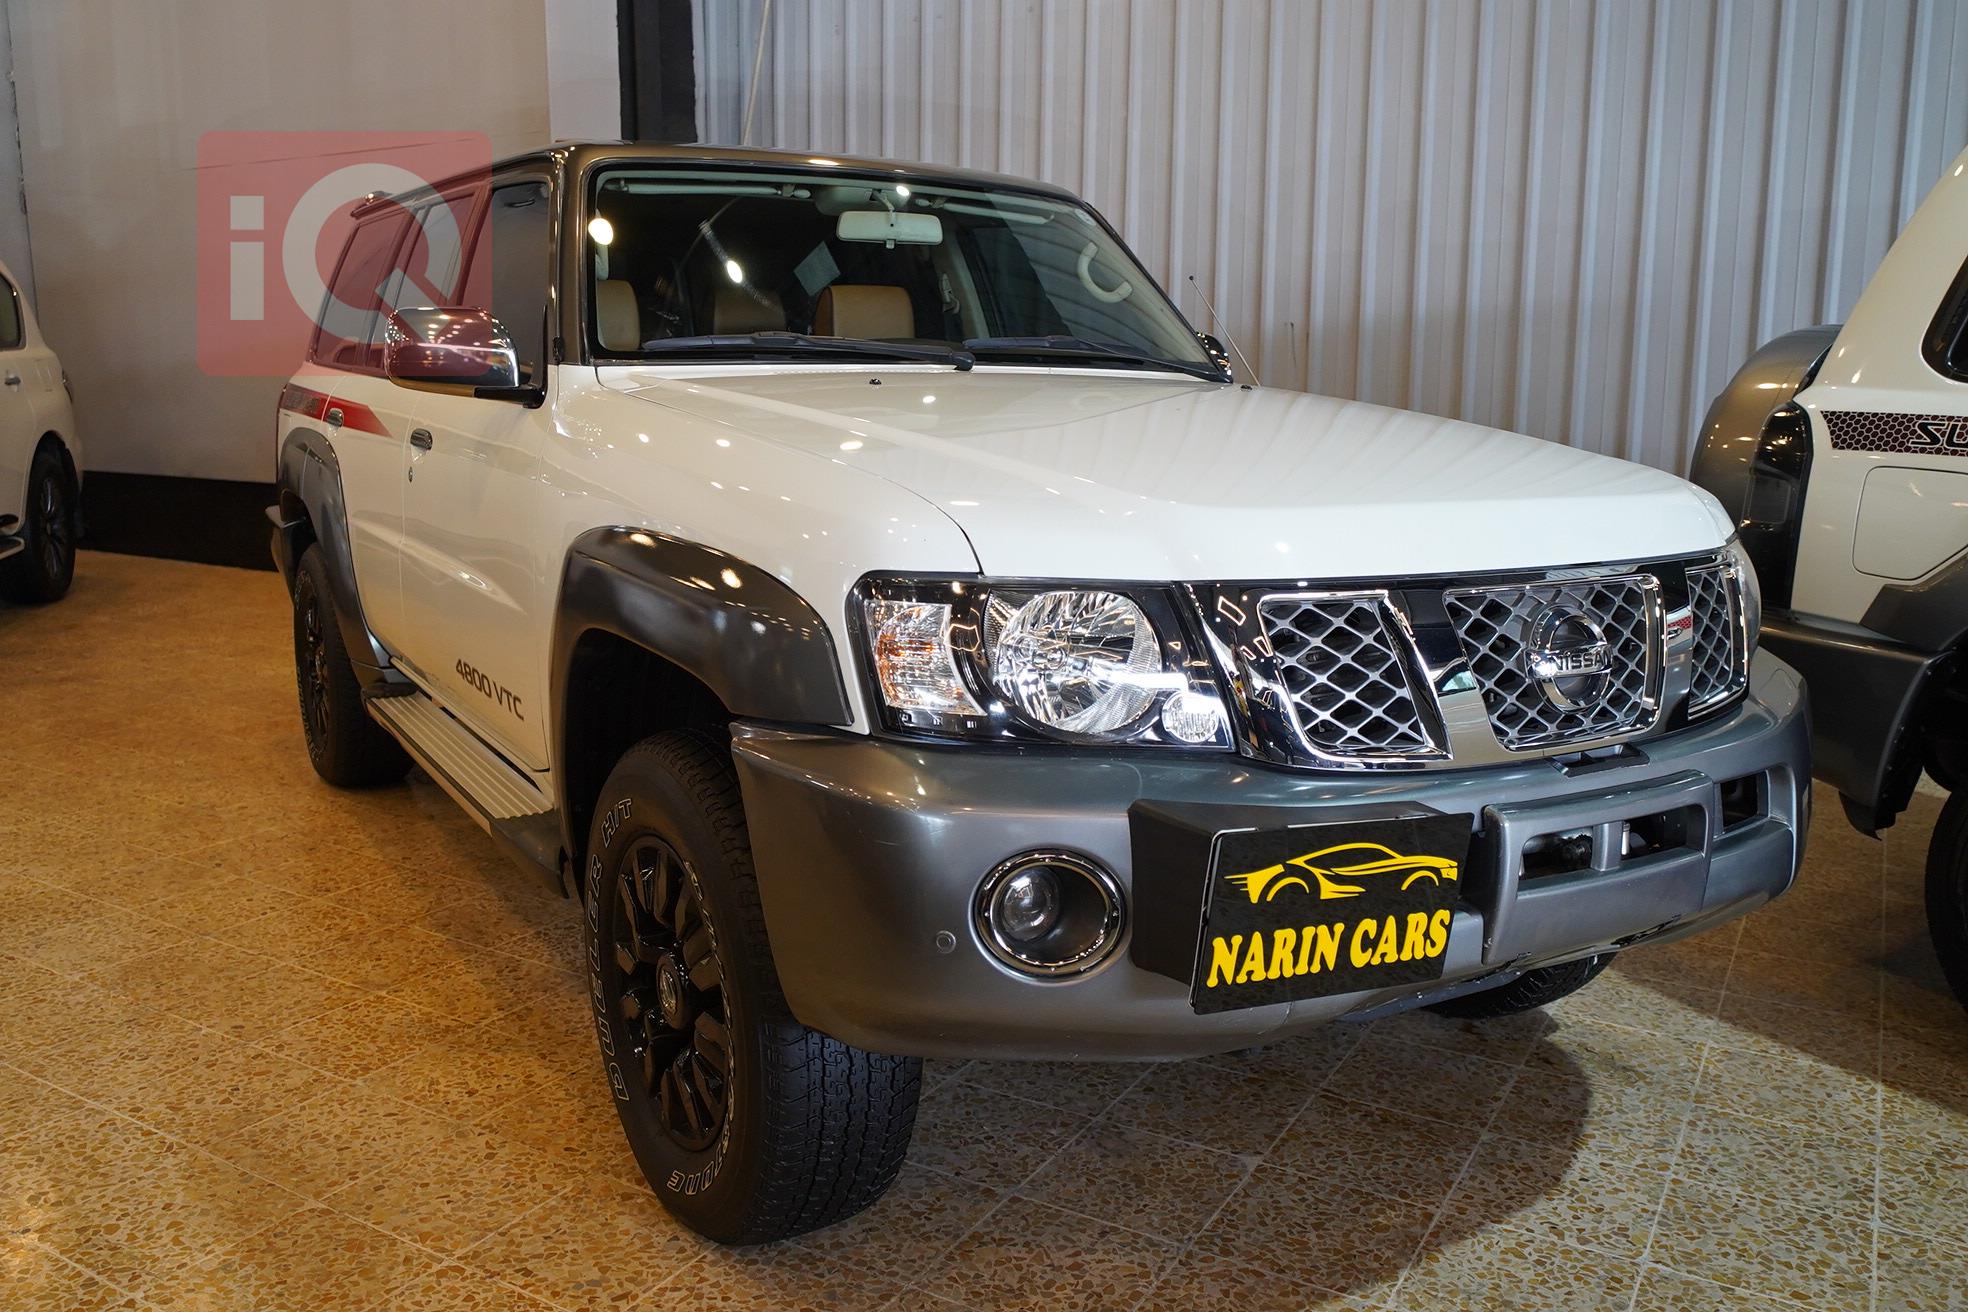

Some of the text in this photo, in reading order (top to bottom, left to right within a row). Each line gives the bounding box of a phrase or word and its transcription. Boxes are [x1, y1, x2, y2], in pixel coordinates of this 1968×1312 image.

[455, 658, 525, 722] 4800 VTC
[1206, 908, 1451, 988] NARIN CARS
